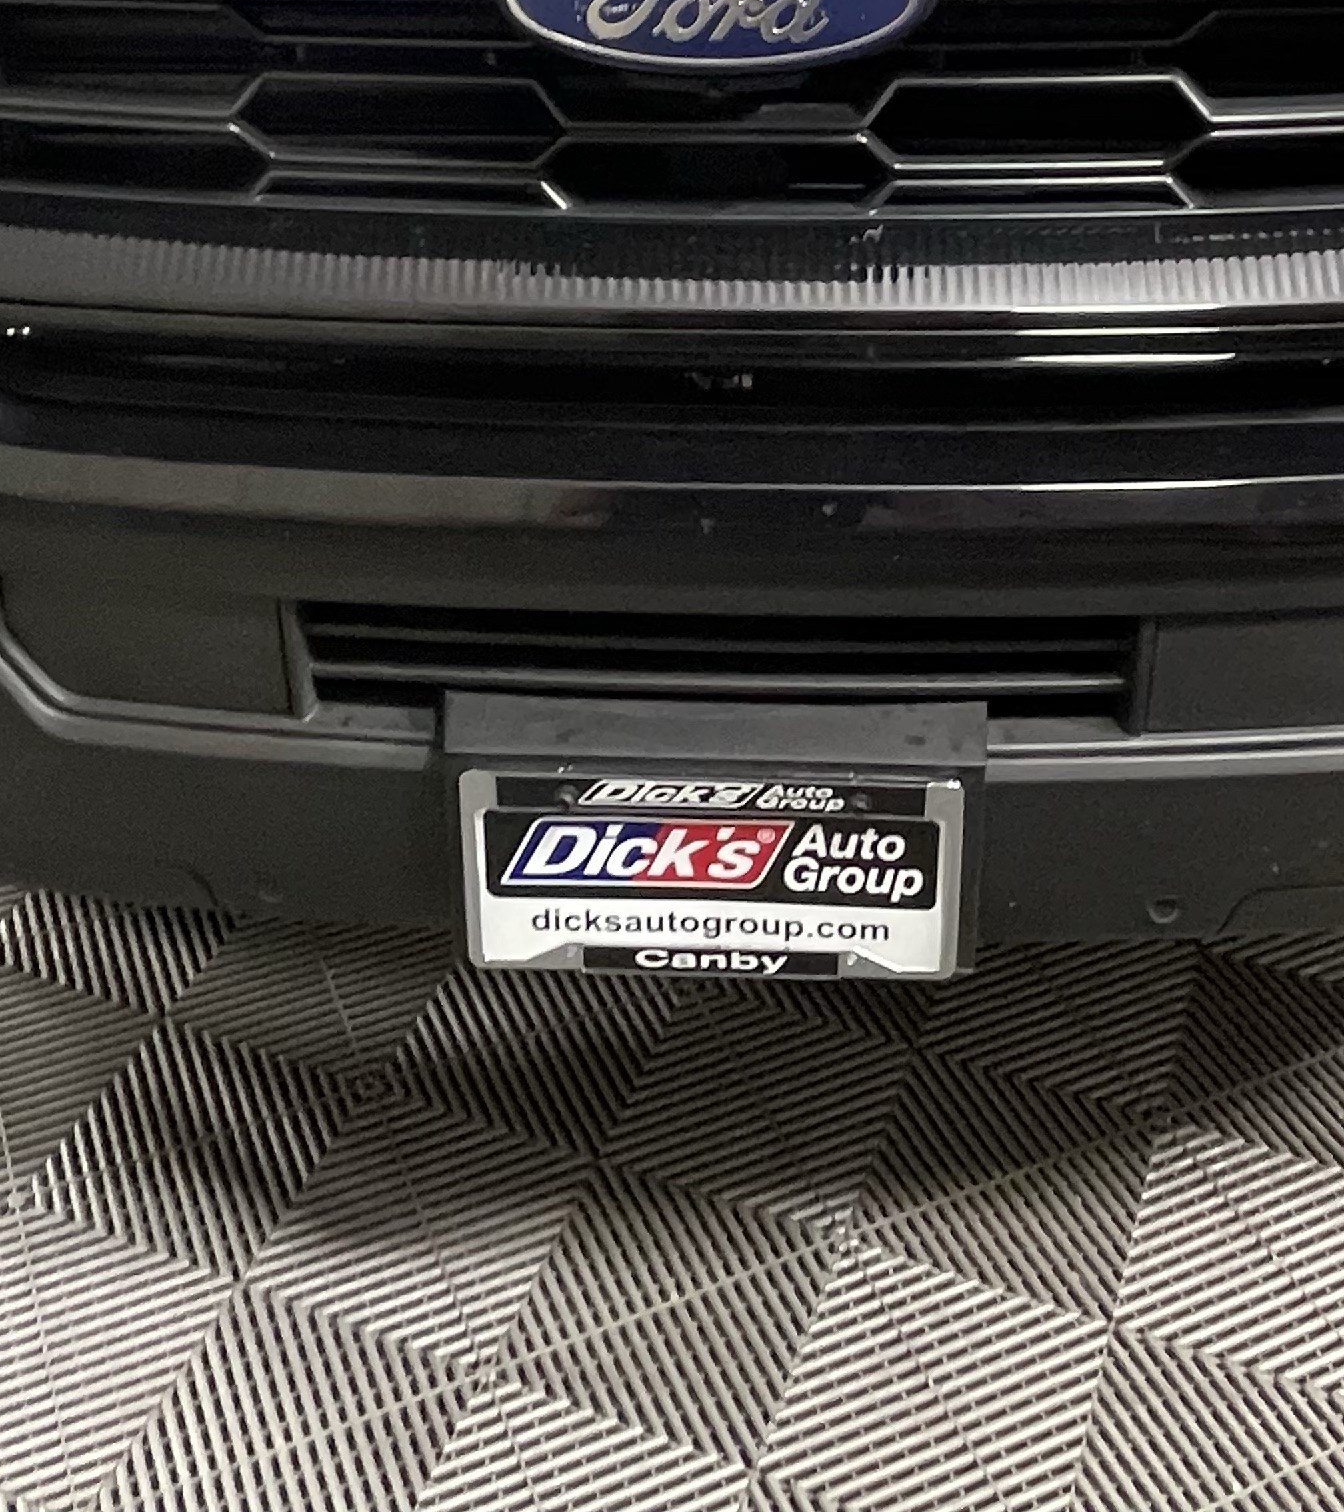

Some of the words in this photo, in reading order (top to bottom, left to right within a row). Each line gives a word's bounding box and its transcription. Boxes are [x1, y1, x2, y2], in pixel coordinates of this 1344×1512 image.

[758, 796, 846, 811] Group
[768, 784, 834, 798] Auto
[792, 824, 906, 862] Auto
[783, 858, 924, 903] Group
[531, 908, 890, 941] dicksautogroup.com
[634, 948, 789, 976] Canby
